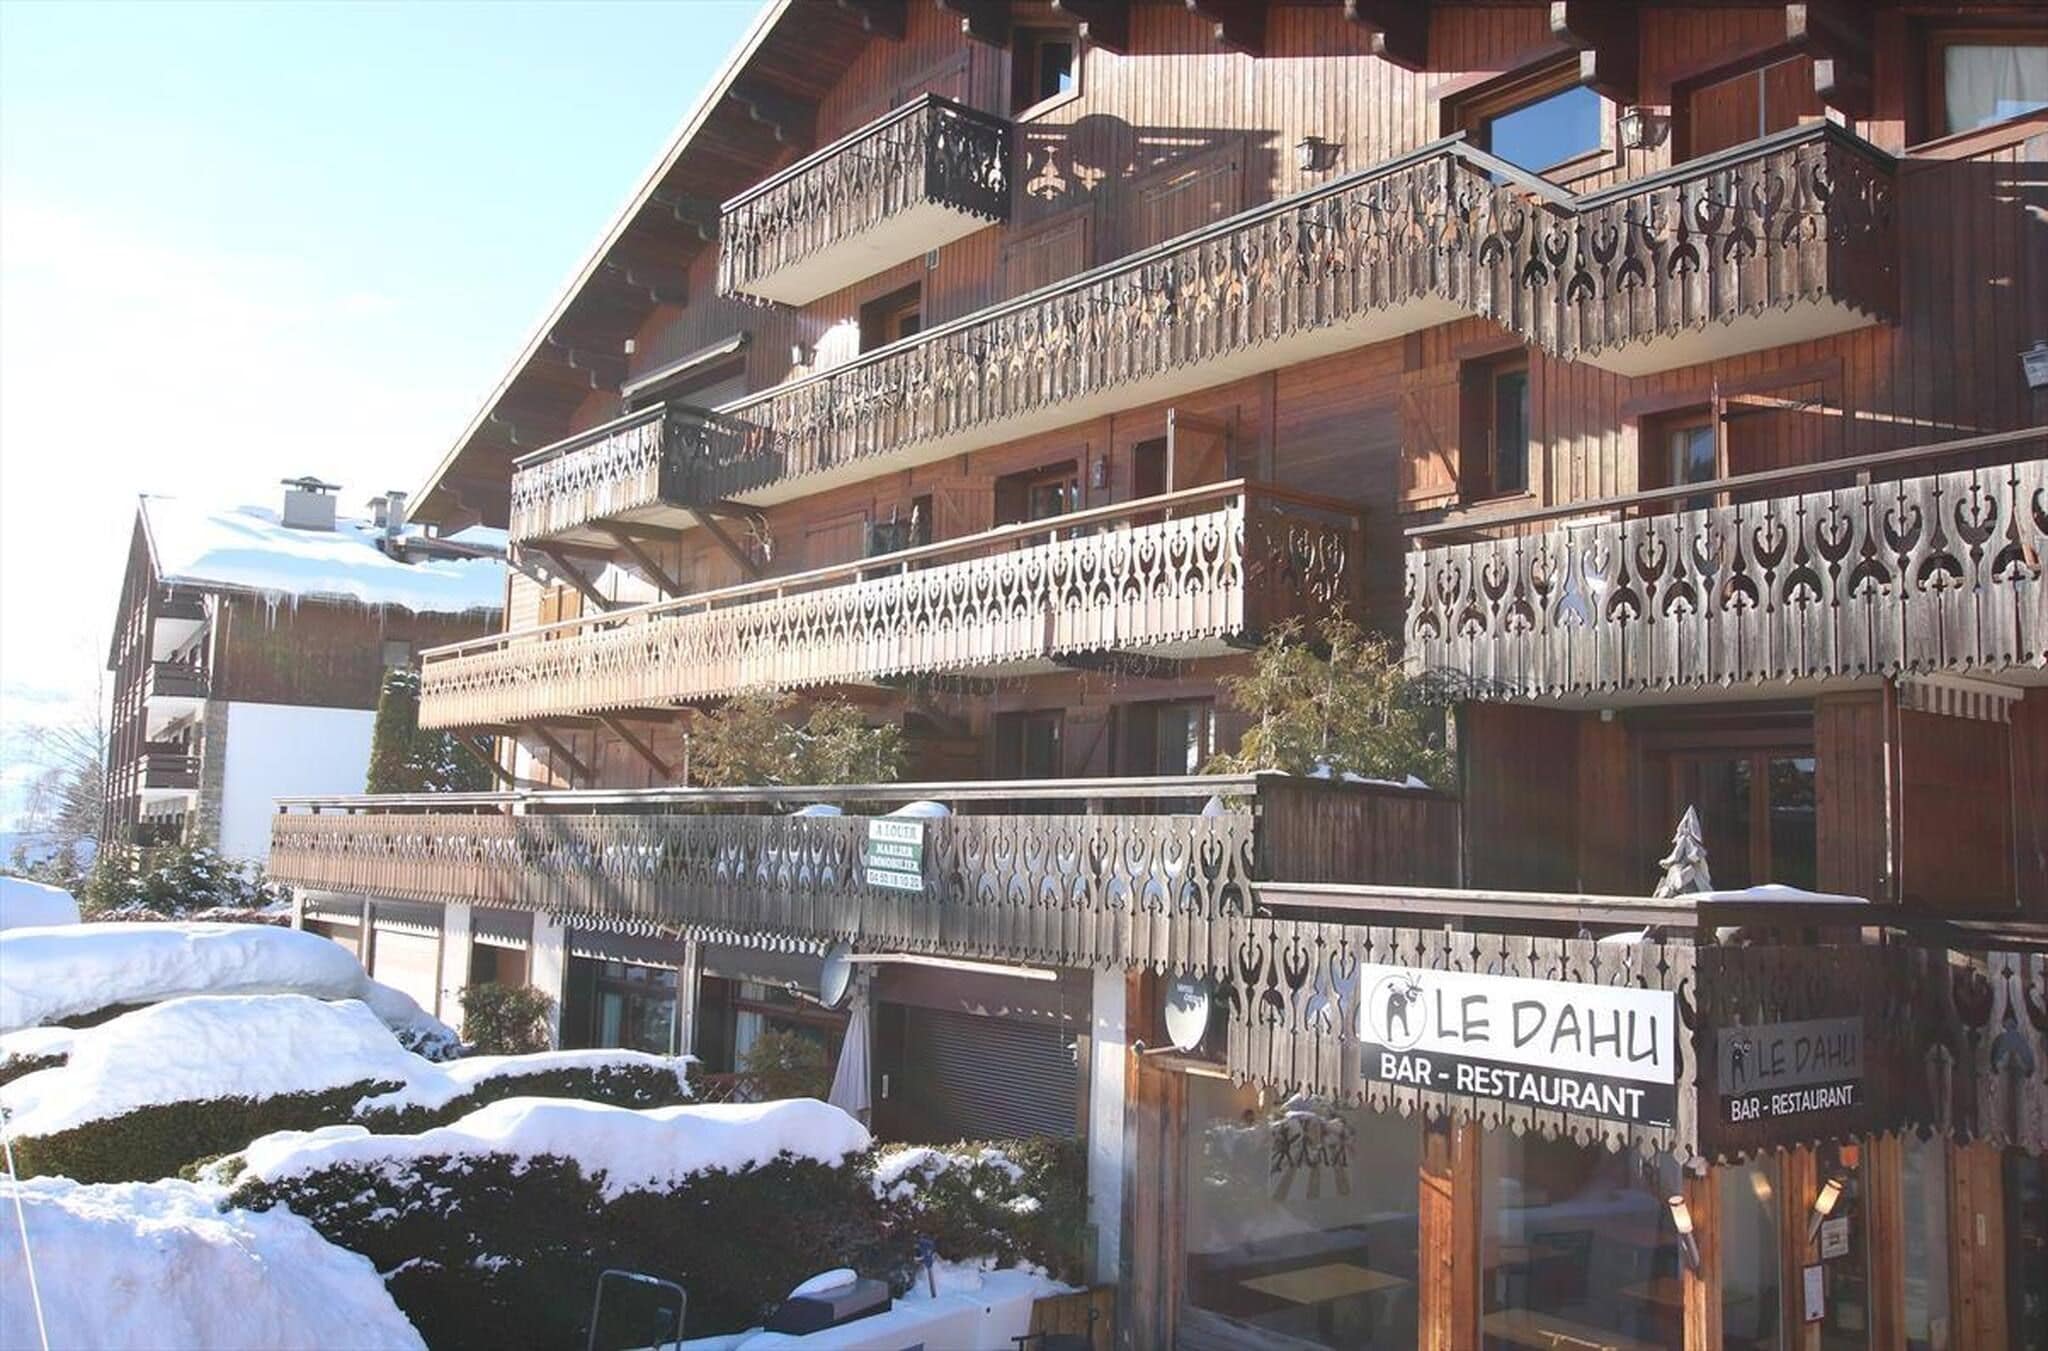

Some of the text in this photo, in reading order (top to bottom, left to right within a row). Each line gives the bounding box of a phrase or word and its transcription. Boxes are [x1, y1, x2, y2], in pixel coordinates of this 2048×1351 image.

[885, 824, 917, 840] LOUER
[1436, 989, 1659, 1066] LE DAHU
[1757, 1031, 1857, 1077] LE DAHU
[1380, 1052, 1431, 1086] BAR
[1456, 1063, 1645, 1119] RESTAURANT
[1731, 1098, 1760, 1121] BAR
[1771, 1085, 1854, 1116] RESTAURANT
